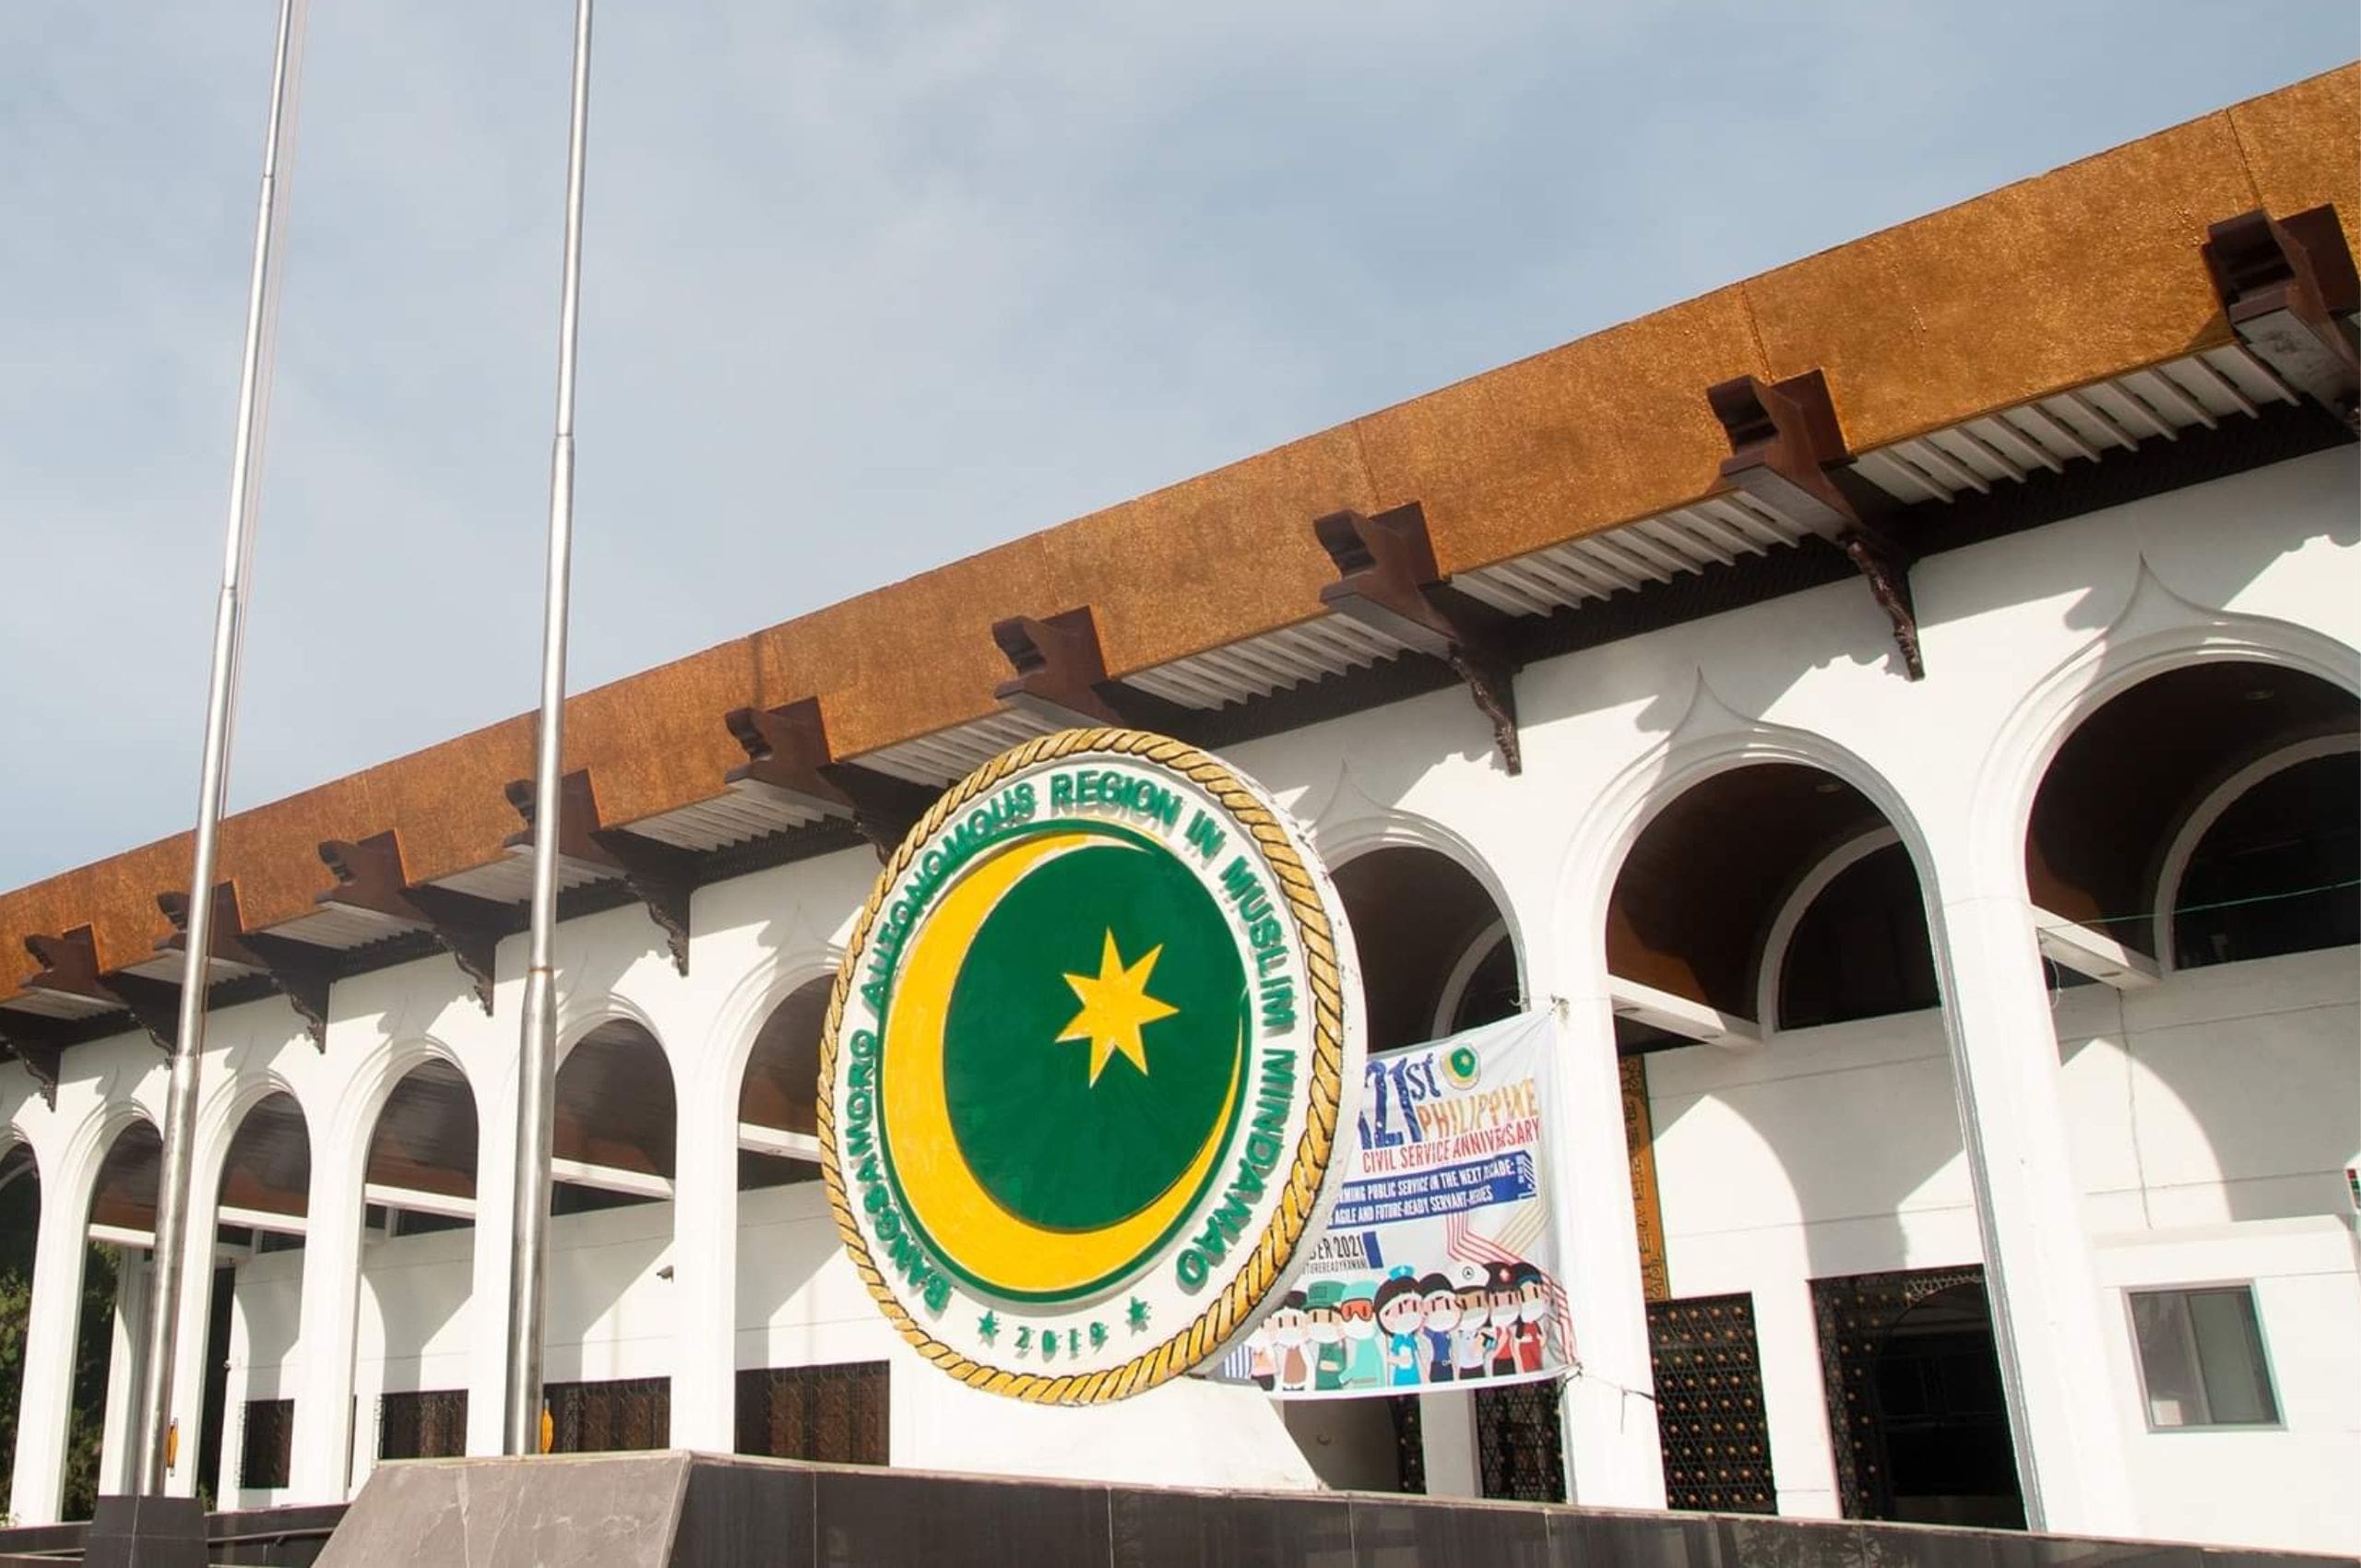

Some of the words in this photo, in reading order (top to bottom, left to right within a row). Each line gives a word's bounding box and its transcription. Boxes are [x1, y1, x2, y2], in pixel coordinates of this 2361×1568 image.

[1050, 770, 1183, 827] REGION
[1184, 809, 1227, 858] IN
[860, 782, 1038, 1010] AUTONOMOUS
[1218, 855, 1298, 1028] MUSLIM
[1416, 1078, 1539, 1140] PHILIPPINE
[845, 1029, 951, 1312] BANGSAMORO
[1176, 1049, 1298, 1286] MINDANAO
[1362, 1148, 1397, 1173] CIVIL
[1401, 1139, 1451, 1169] SERVICE
[1335, 1207, 1356, 1224] AGILE
[1358, 1205, 1374, 1221] AND
[1375, 1196, 1430, 1219] FUTURE-READY
[1368, 1183, 1396, 1200] PUBLIC
[1398, 1179, 1429, 1197] SERVICE
[1430, 1176, 1440, 1192] IN
[1441, 1171, 1459, 1190] THE
[1460, 1167, 1482, 1185] NEXT
[1333, 1235, 1365, 1258] 2021
[1015, 1322, 1109, 1356] 2019
